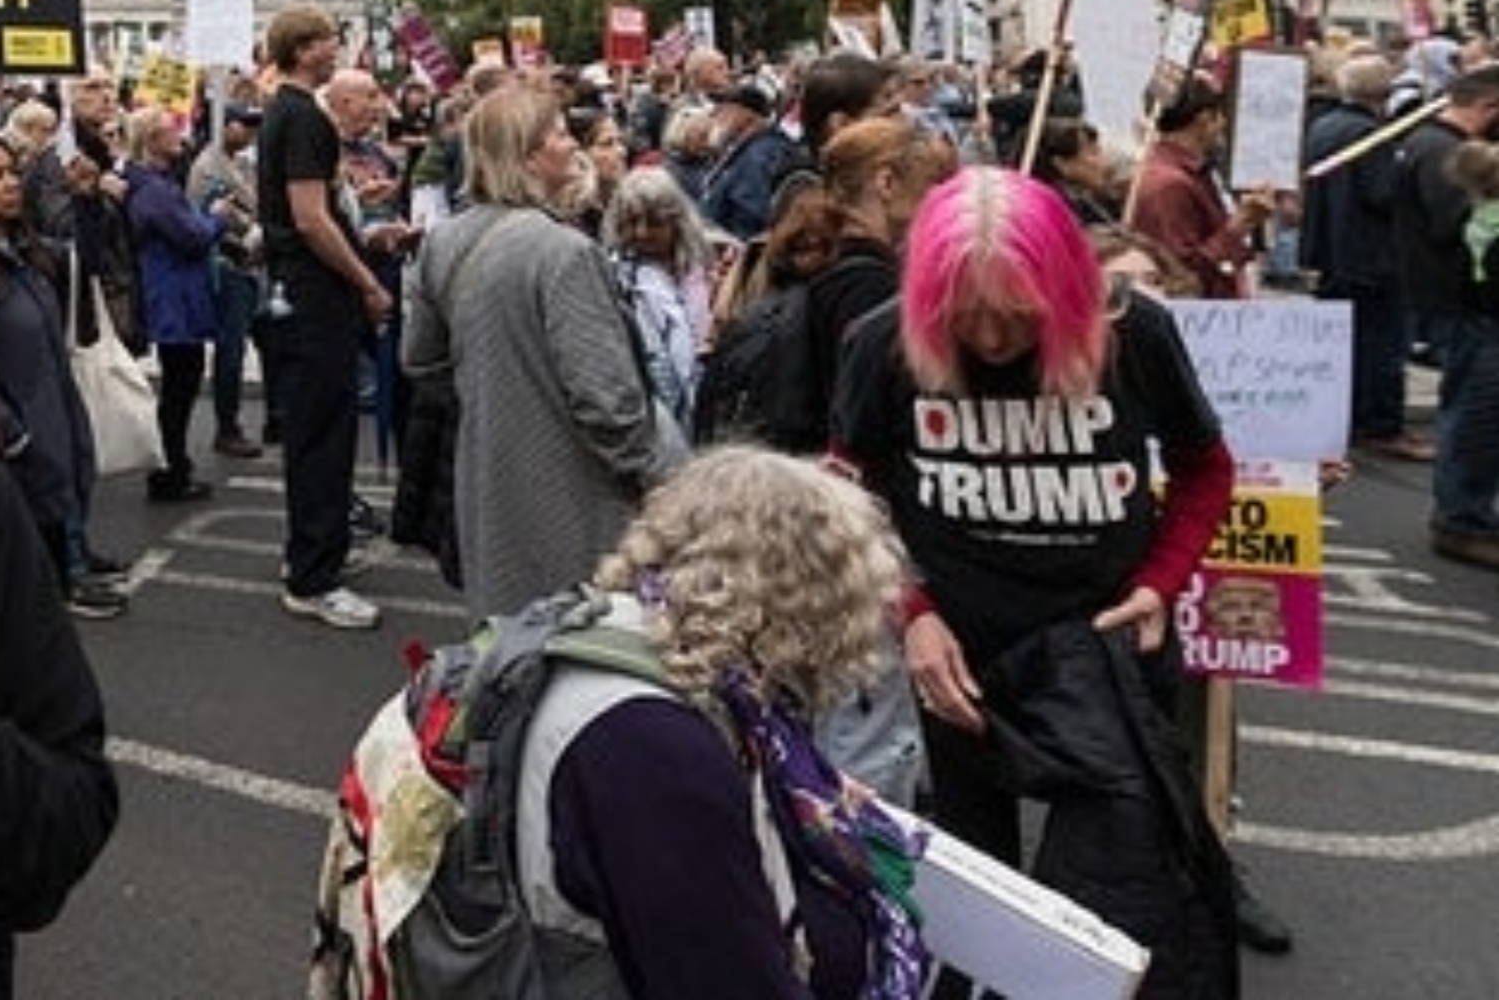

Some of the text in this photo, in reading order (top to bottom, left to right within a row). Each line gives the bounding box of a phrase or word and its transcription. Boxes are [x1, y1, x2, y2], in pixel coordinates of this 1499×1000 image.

[913, 394, 1114, 456] DUMP
[910, 455, 1137, 523] TRUMP
[1207, 530, 1298, 564] CISM
[1178, 634, 1291, 674] RUMP
